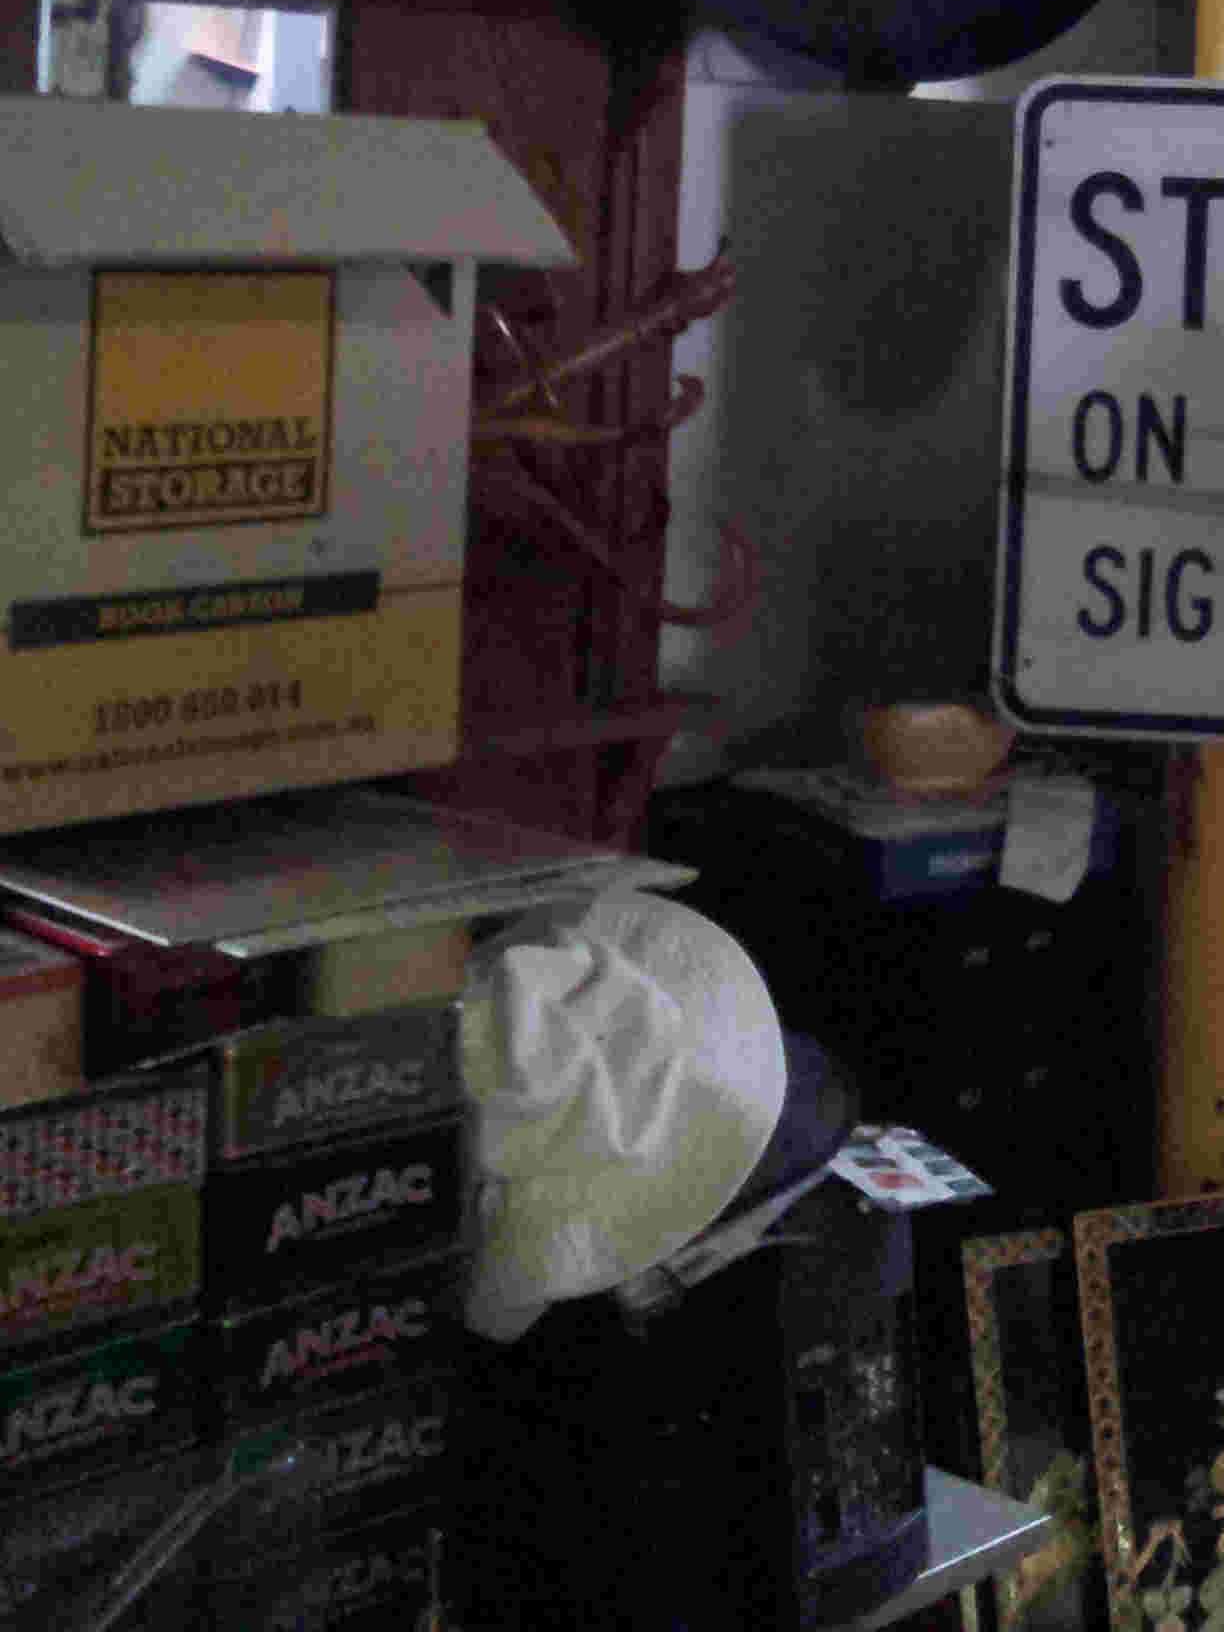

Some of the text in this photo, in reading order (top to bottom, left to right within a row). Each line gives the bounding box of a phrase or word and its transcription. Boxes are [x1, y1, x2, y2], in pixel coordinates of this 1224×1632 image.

[101, 416, 318, 458] NATIONAL
[1072, 389, 1187, 486] ON
[272, 1059, 424, 1129] ANZAC
[265, 1164, 433, 1253] ANZAC
[0, 1241, 158, 1313] NZAC
[260, 1301, 429, 1387] ANZAC
[0, 1374, 157, 1456] NZAC
